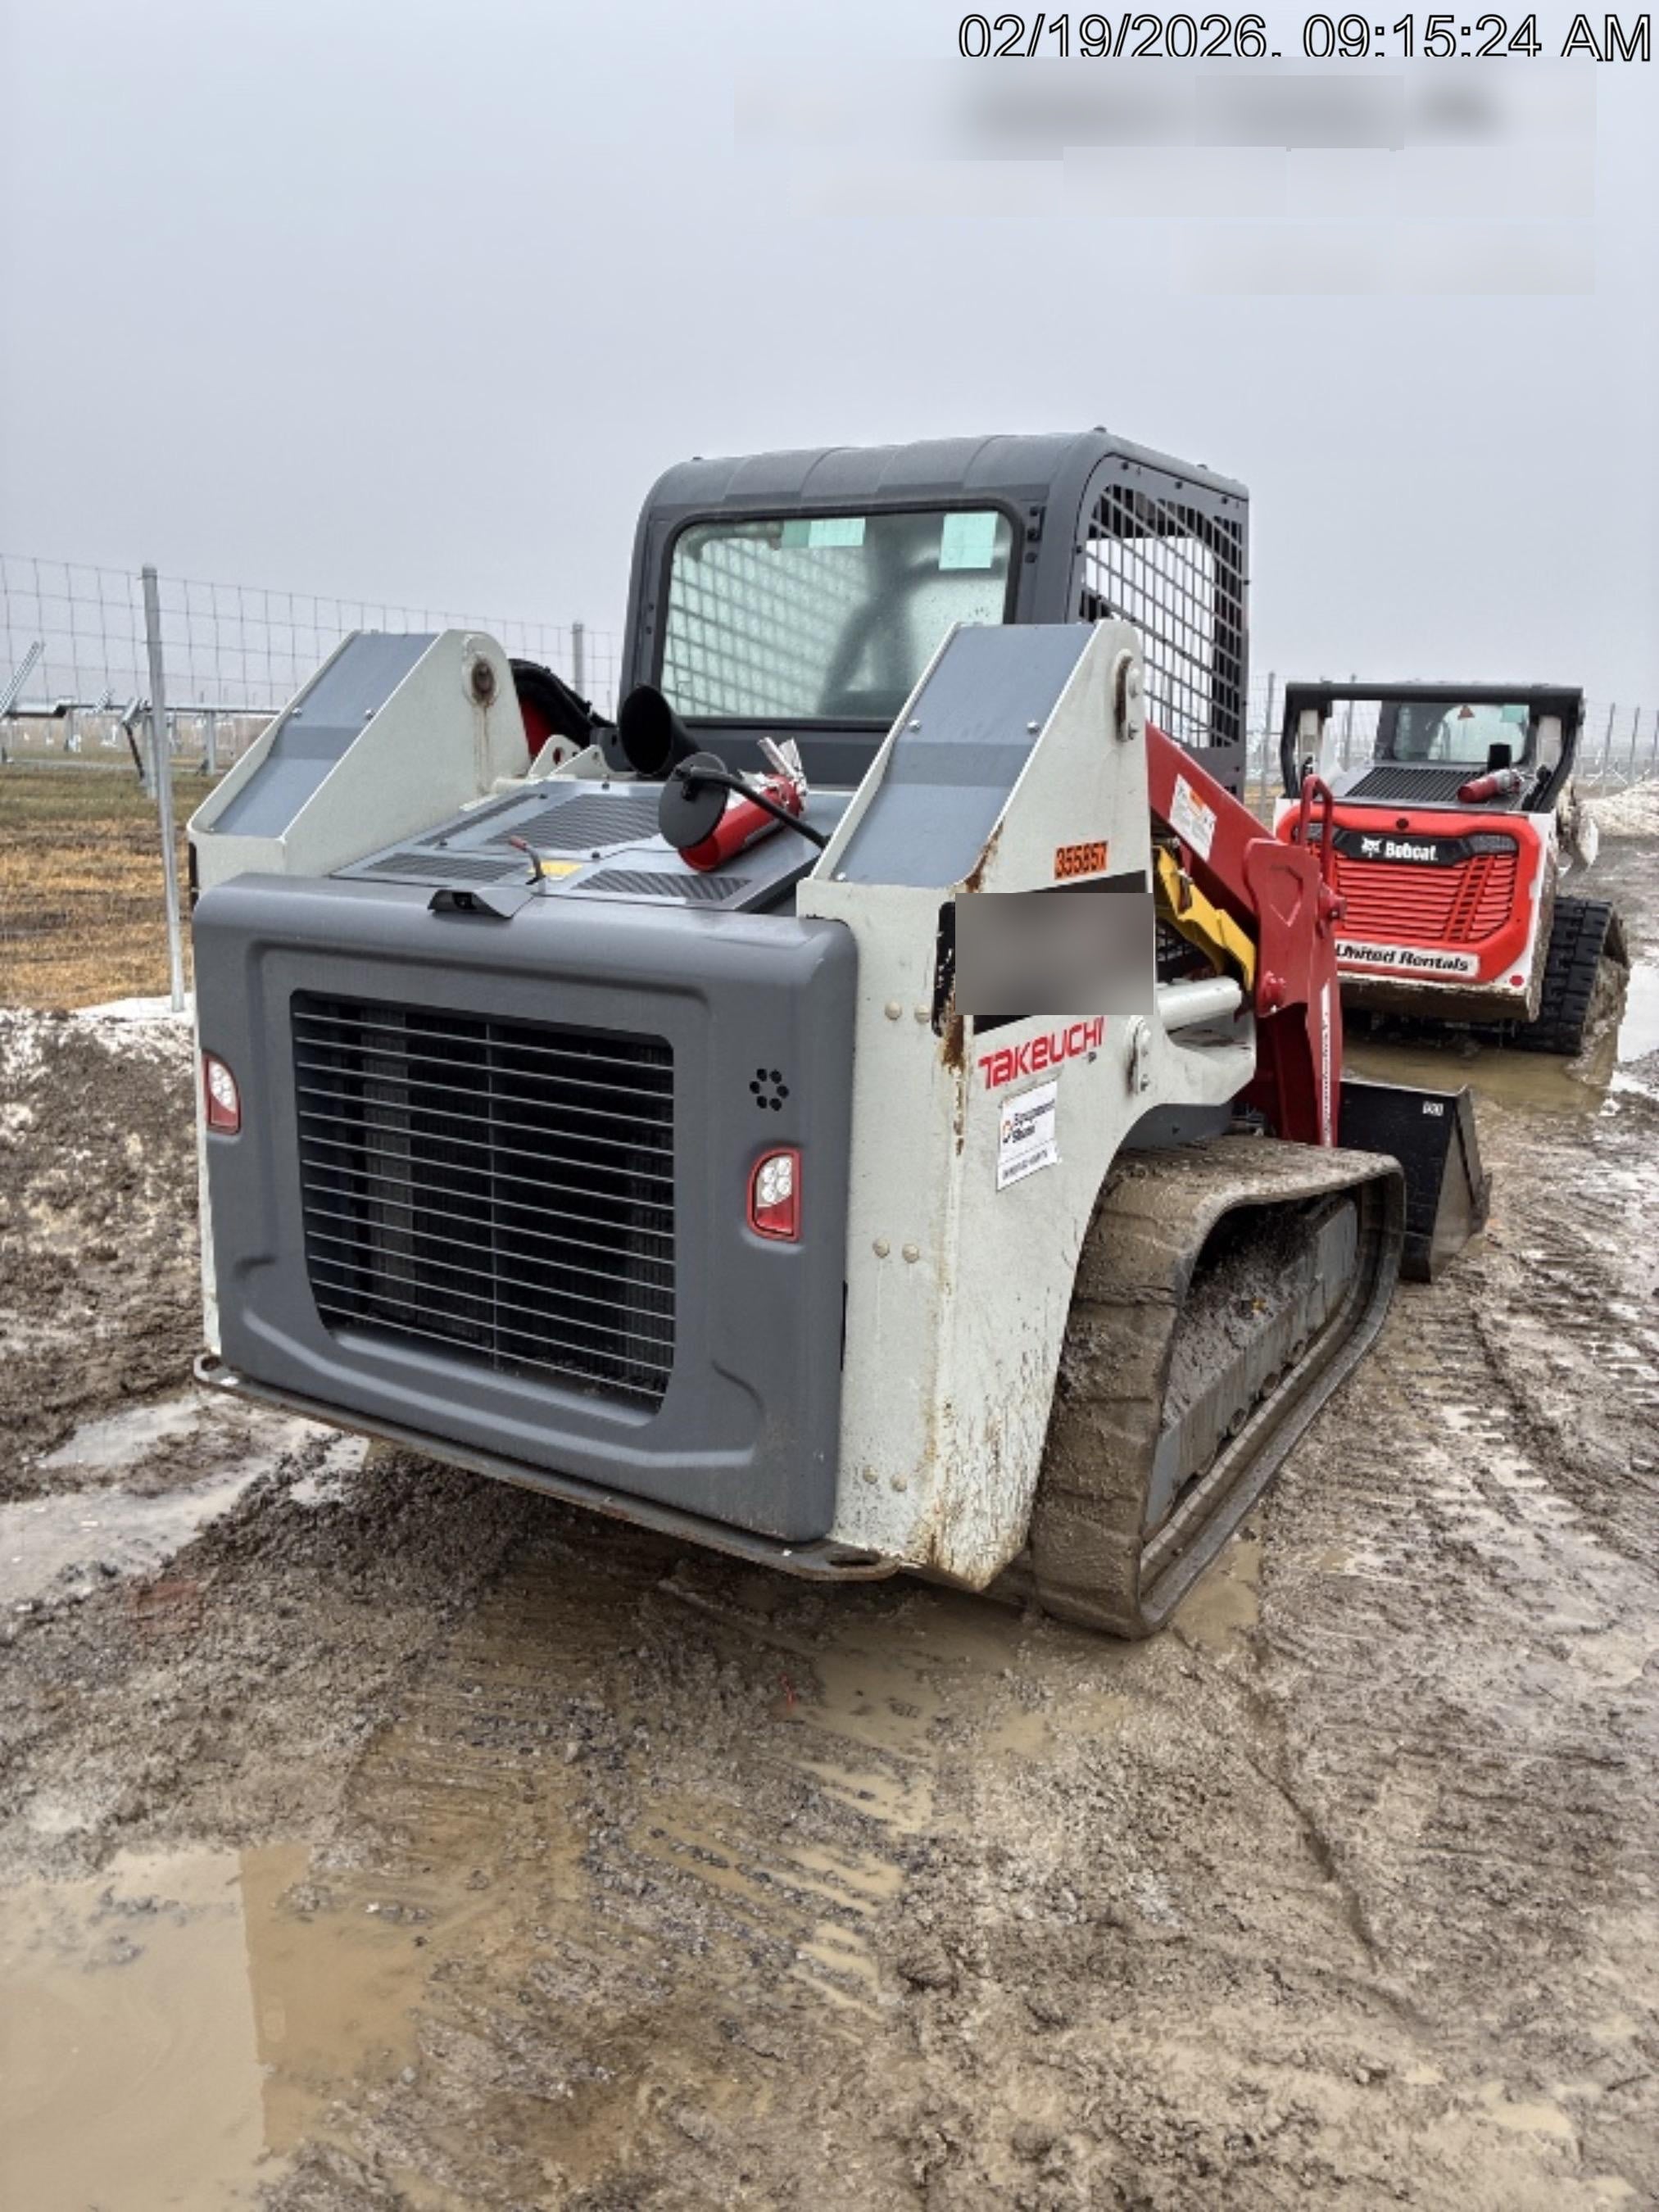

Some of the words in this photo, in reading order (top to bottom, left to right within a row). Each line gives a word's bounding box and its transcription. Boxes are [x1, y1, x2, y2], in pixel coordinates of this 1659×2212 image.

[1385, 841, 1437, 861] Bobcat
[1336, 944, 1396, 963] United
[1398, 950, 1469, 972] Rentals
